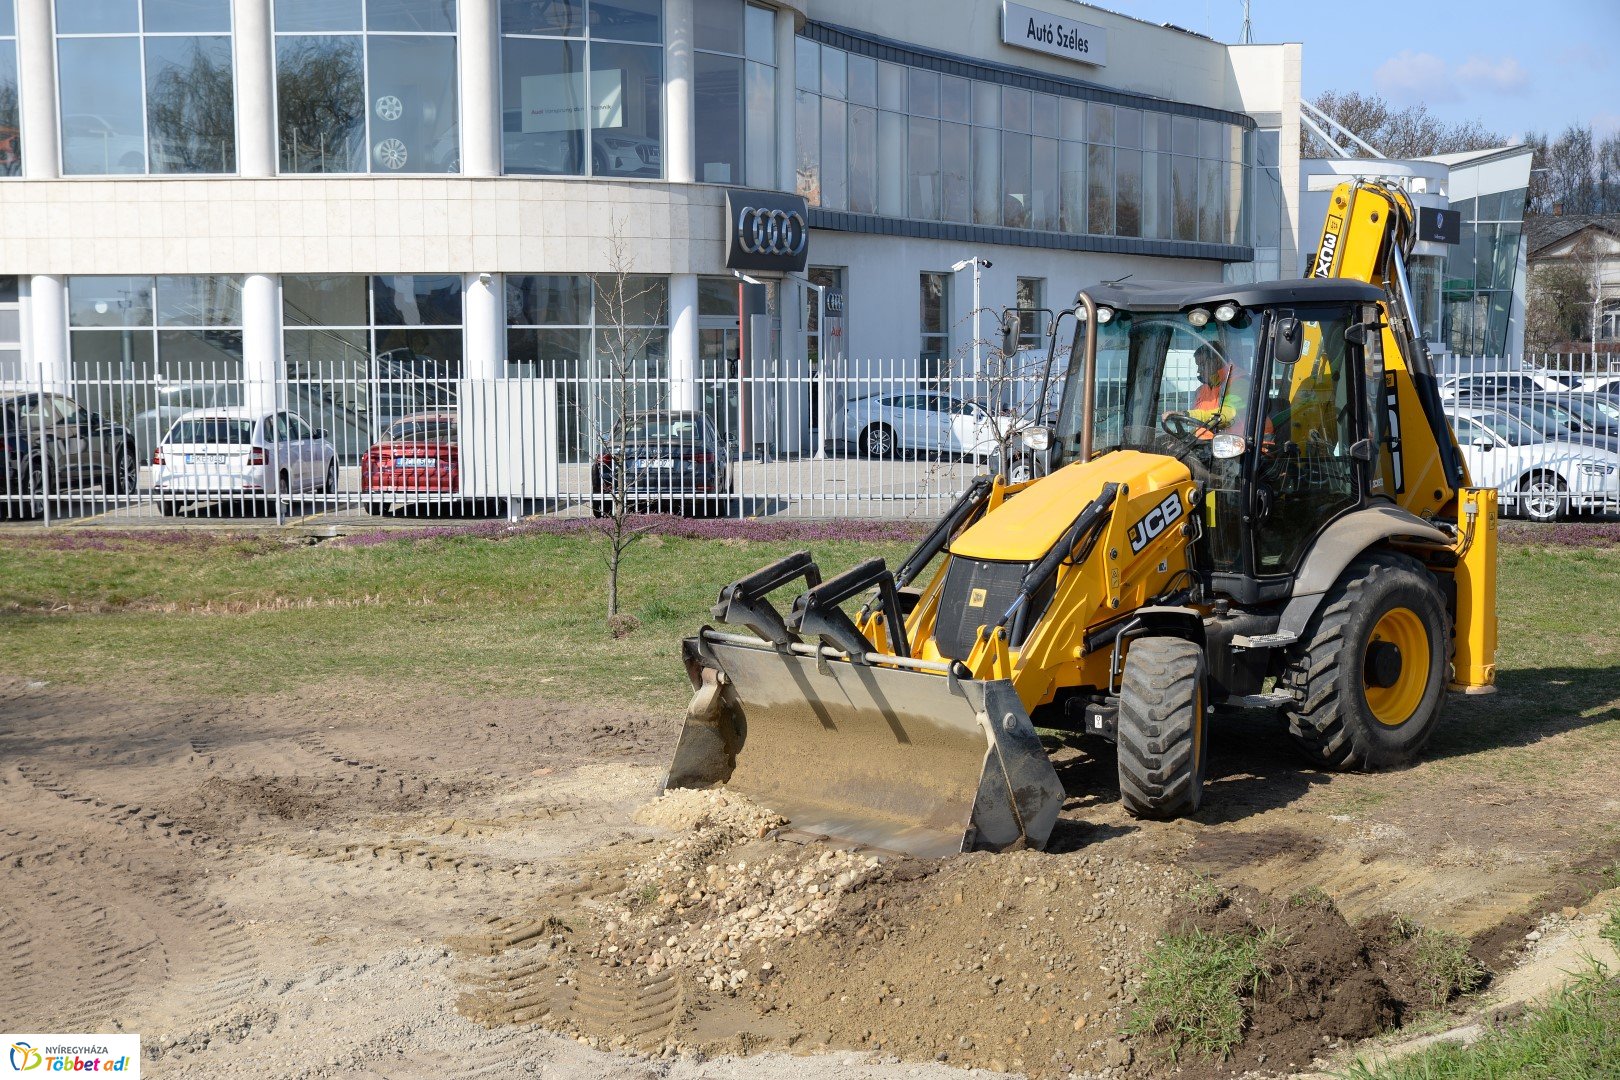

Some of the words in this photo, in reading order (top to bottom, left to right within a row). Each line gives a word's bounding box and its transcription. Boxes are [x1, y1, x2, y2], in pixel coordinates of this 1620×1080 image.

[1026, 17, 1054, 44] Autó
[1057, 24, 1089, 53] Széles
[1131, 493, 1182, 552] JCB
